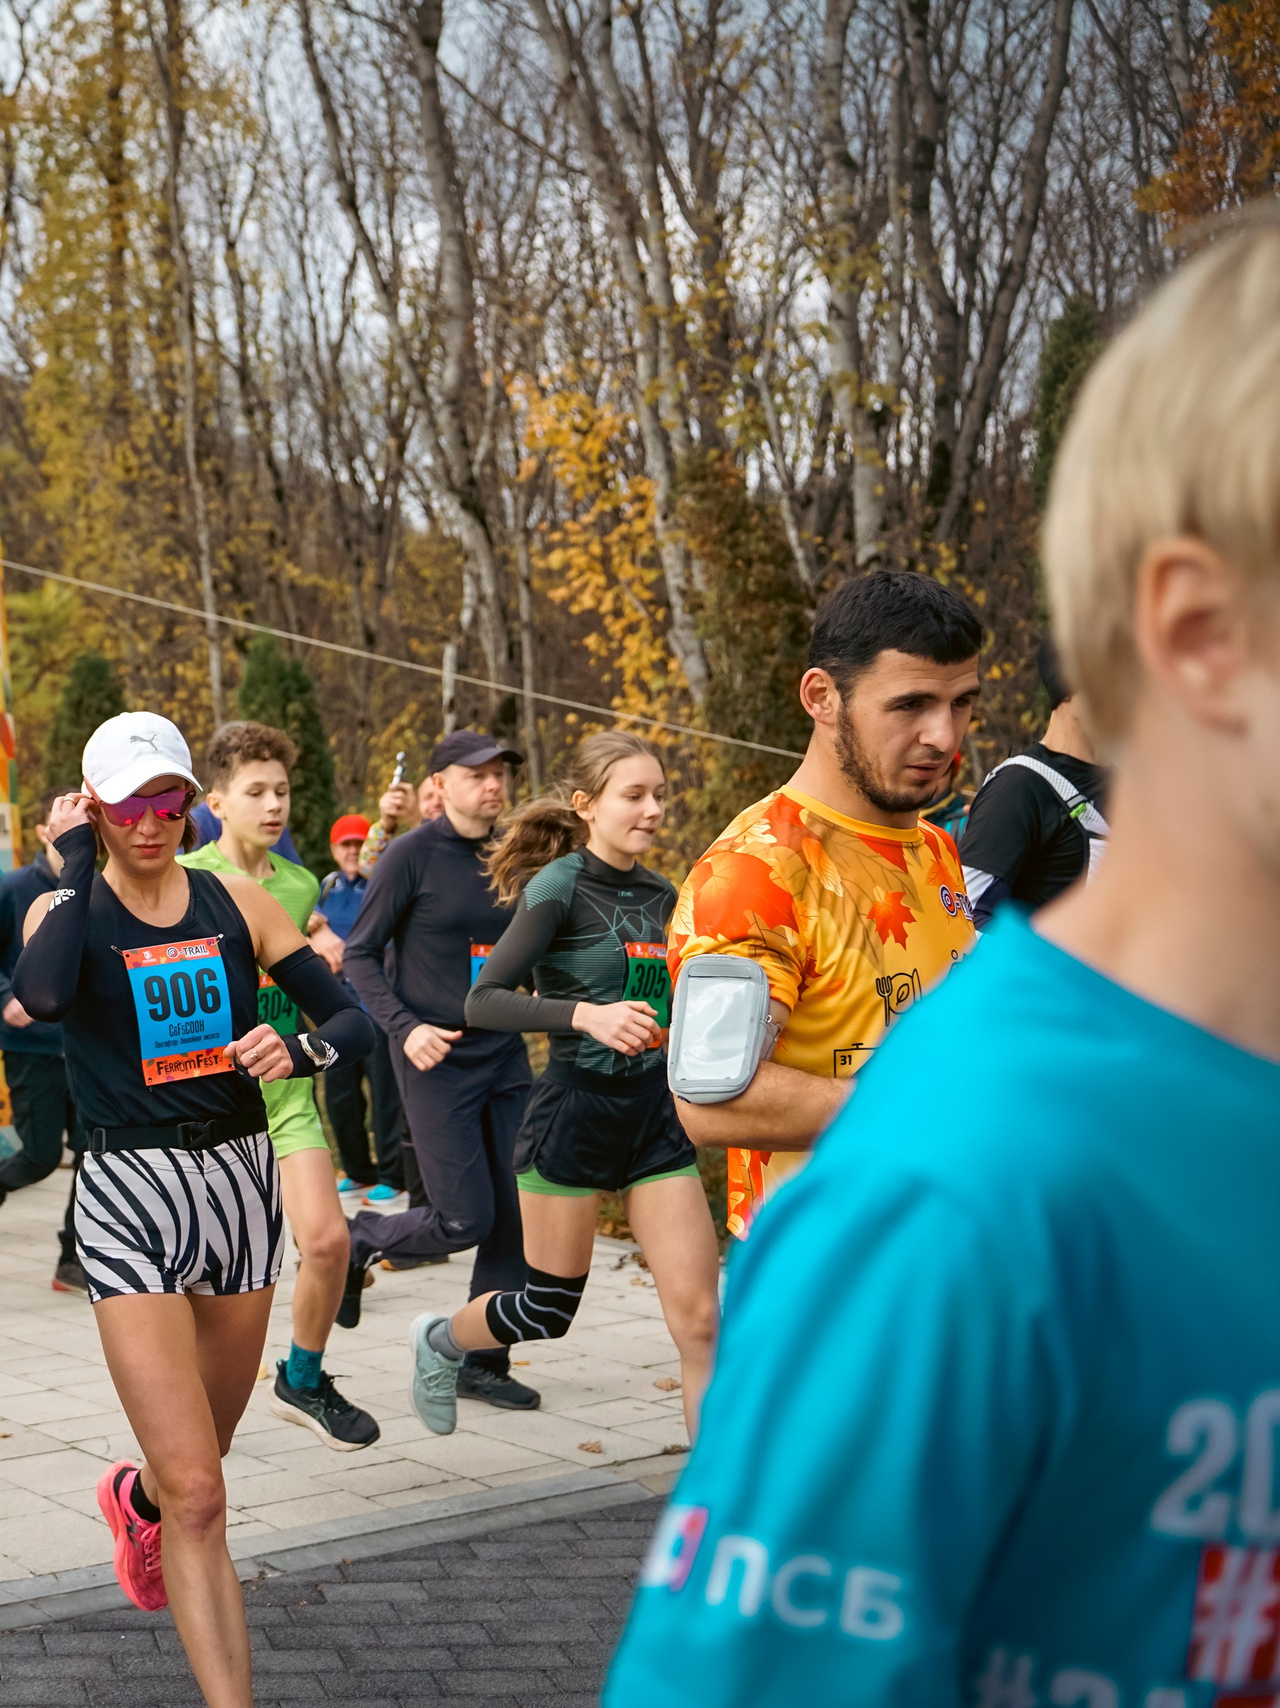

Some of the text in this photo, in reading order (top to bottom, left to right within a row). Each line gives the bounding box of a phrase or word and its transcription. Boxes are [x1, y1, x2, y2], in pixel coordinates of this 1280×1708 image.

[144, 968, 221, 1022] 906
[630, 963, 667, 999] 305
[258, 990, 294, 1023] 304
[840, 1055, 852, 1065] 31
[705, 1535, 907, 1641] ПСБ
